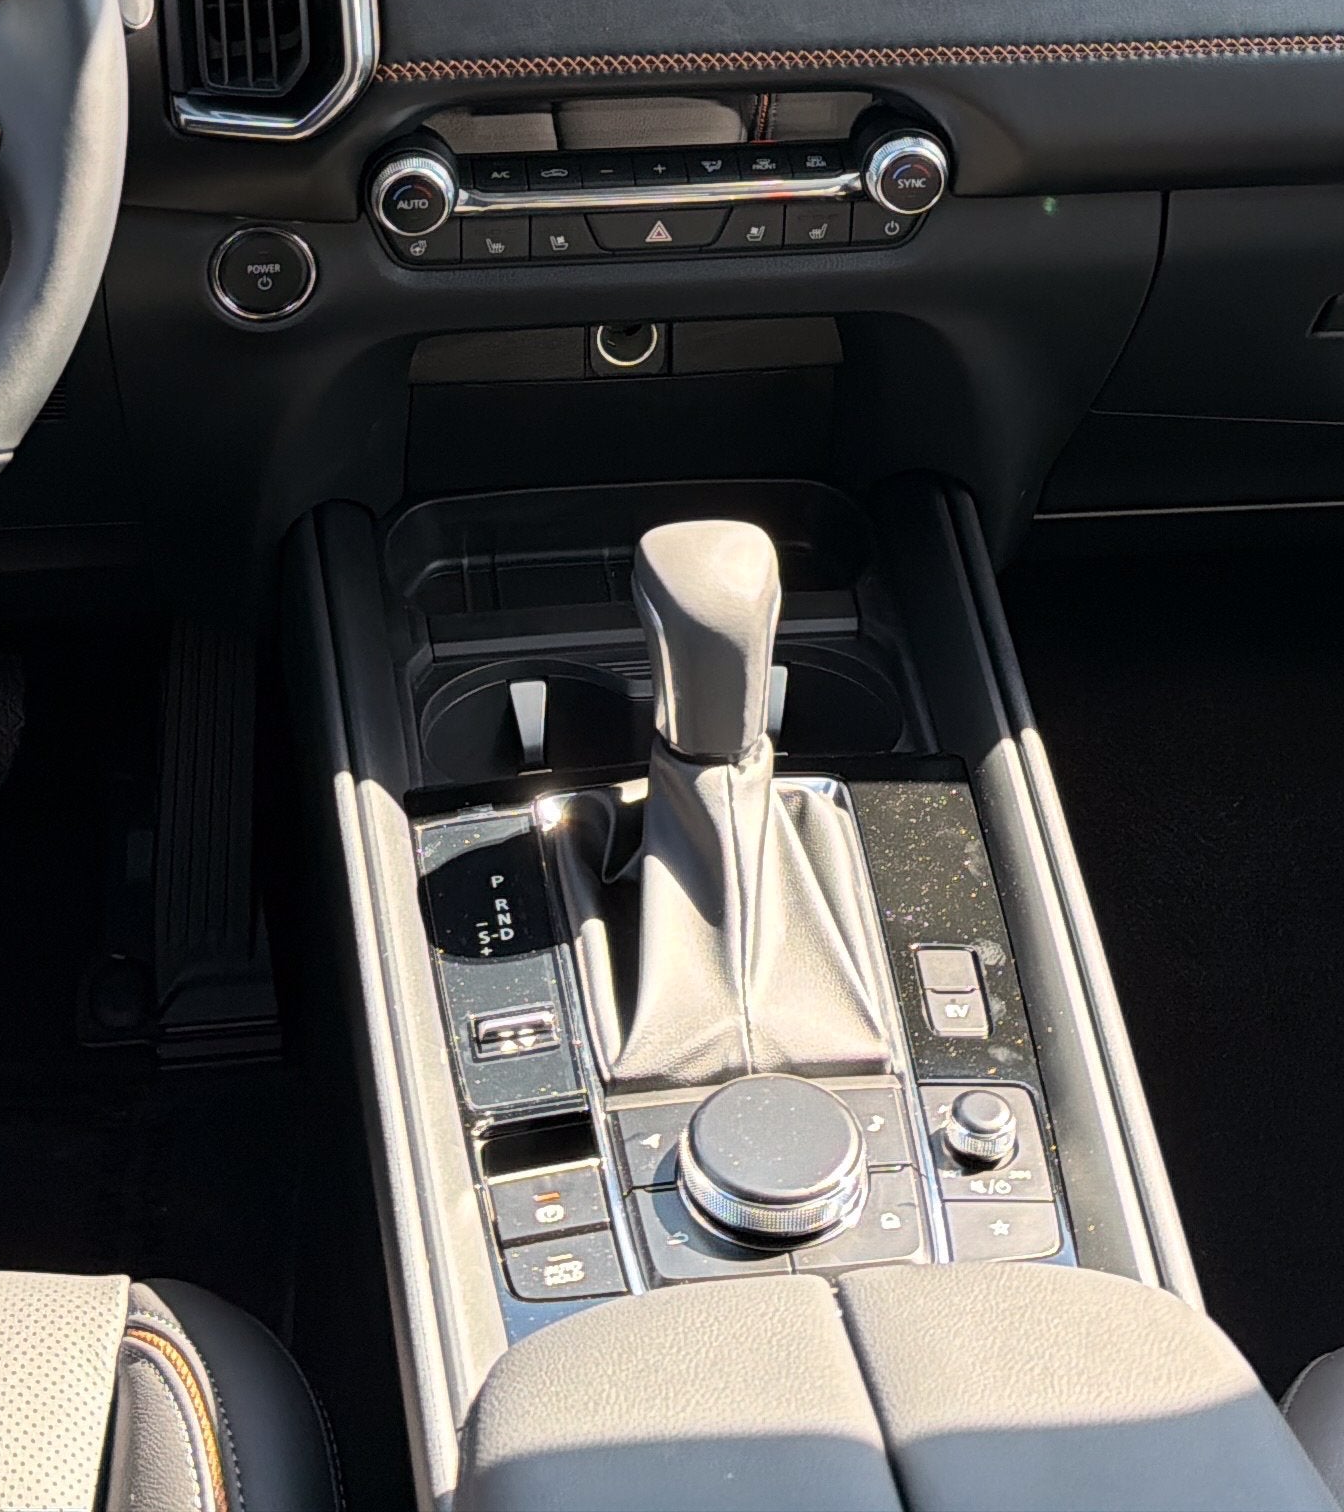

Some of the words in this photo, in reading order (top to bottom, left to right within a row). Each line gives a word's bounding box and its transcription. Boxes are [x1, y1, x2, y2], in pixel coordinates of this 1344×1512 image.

[897, 178, 926, 189] SYNC
[397, 199, 429, 210] AUTO
[247, 264, 281, 274] POWER
[490, 875, 504, 889] P
[494, 898, 509, 912] R
[497, 912, 512, 926] N
